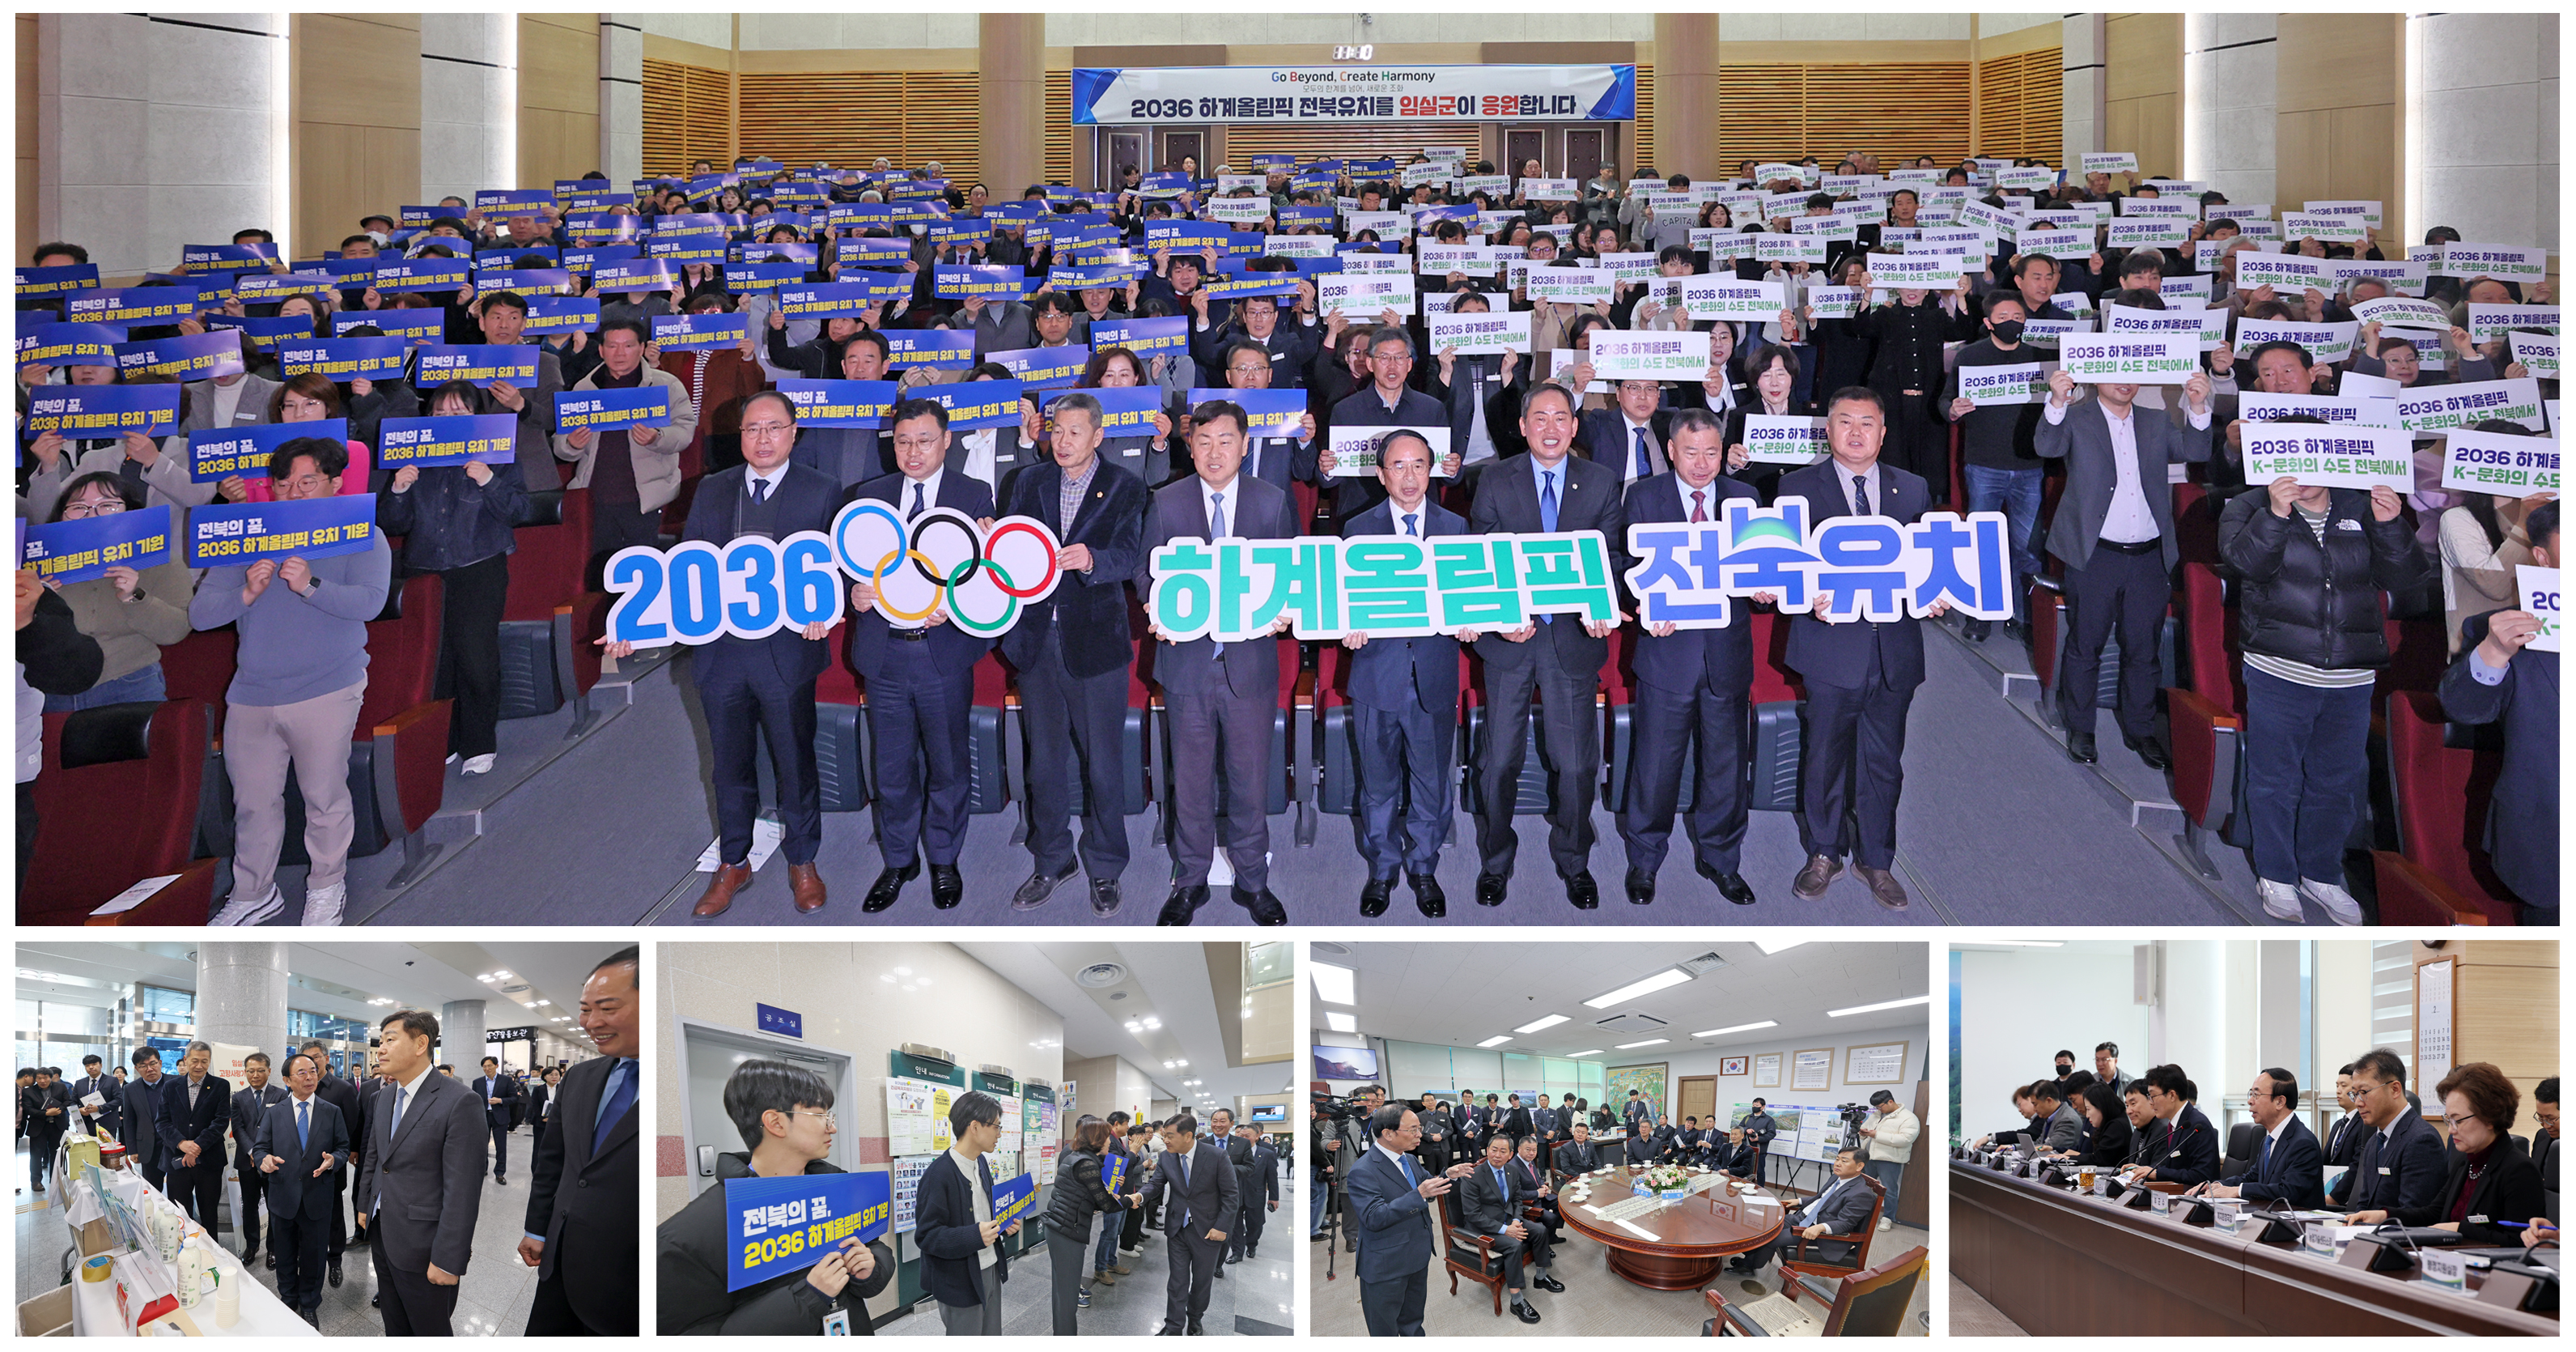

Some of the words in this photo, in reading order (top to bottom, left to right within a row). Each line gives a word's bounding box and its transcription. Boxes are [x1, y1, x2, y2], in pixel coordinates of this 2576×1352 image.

[1335, 45, 1373, 61] 11:10
[1272, 72, 1286, 82] Go
[1290, 71, 1336, 83] Beyond,
[1340, 71, 1378, 82] Create
[1382, 71, 1435, 83] Harmony
[1131, 99, 1194, 117] 2036
[1199, 96, 1294, 117] 하계올림픽
[1299, 96, 1394, 117] 전북유치를
[1399, 96, 1475, 116] 임실군이
[1482, 95, 1577, 116] 응원합니다
[1148, 228, 1169, 238] 전북의
[1171, 228, 1181, 237] 꿈,
[2113, 225, 2134, 233] 2036
[2137, 223, 2171, 232] 하계올림픽
[1148, 240, 1168, 249] 2036
[1170, 238, 1199, 247] 하계올림픽
[1201, 237, 1213, 246] 유치
[1216, 237, 1228, 246] 기원
[1778, 240, 1810, 248] 하계올림픽
[2112, 234, 2141, 242] K-문화의
[2158, 232, 2186, 240] 전북에서
[840, 245, 859, 253] 전북의
[860, 245, 868, 253] 꿈,
[858, 253, 883, 261] 하계올림픽
[2450, 253, 2480, 261] 2036
[2482, 252, 2524, 263] 하계올림픽
[2448, 262, 2489, 272] K-문화의
[2491, 264, 2509, 274] 수도
[2511, 263, 2541, 274] 전북에서
[1687, 291, 1716, 299] 2036
[1718, 289, 1761, 300] 하계올림픽
[71, 300, 105, 311] 전북의
[109, 298, 123, 309] 꿈,
[1687, 301, 1724, 312] K-문화의
[1727, 300, 1745, 311] 수도
[1747, 300, 1781, 311] 전북에서
[72, 312, 103, 322] 2036
[106, 308, 151, 320] 하계올림픽
[155, 305, 172, 316] 유치
[175, 303, 193, 314] 기원
[656, 325, 680, 334] 전북의
[681, 324, 693, 334] 꿈,
[1435, 325, 1462, 335] 2036
[1465, 321, 1507, 333] 하계올림픽
[656, 336, 678, 346] 2036
[681, 332, 714, 343] 하계올림픽
[715, 331, 728, 340] 유치
[731, 329, 744, 339] 기원
[1435, 337, 1471, 347] K-문화의
[1475, 335, 1491, 344] 수도
[1494, 332, 1526, 342] 전북에서
[2067, 347, 2104, 359] 2036
[2108, 345, 2166, 357] 하계올림픽
[422, 356, 452, 368] 전북의
[456, 355, 469, 367] 꿈,
[2067, 361, 2117, 374] K-문화의
[2120, 359, 2144, 372] 수도
[2147, 359, 2193, 372] 전북에서
[421, 371, 449, 381] 2036
[452, 368, 494, 379] 하계올림픽
[498, 367, 516, 378] 유치
[518, 365, 534, 377] 기원
[32, 400, 65, 413] 전북의
[68, 398, 83, 412] 꿈,
[560, 402, 588, 415] 전북의
[591, 400, 604, 411] 꿈,
[29, 418, 59, 430] 2036
[62, 414, 117, 427] 하계올림픽
[121, 412, 145, 424] 유치
[148, 409, 172, 423] 기원
[561, 415, 588, 427] 2036
[590, 410, 630, 423] 하계올림픽
[631, 407, 647, 419] 유치
[649, 406, 666, 417] 기원
[384, 430, 417, 445] 전북의
[420, 429, 435, 443] 꿈,
[384, 448, 414, 461] 2036
[416, 442, 465, 457] 하계올림픽
[467, 440, 487, 453] 유치
[490, 437, 510, 451] 기원
[2251, 441, 2299, 454] 2036
[2304, 439, 2374, 455] 하계올림픽
[2252, 459, 2318, 474] K-문화의
[2323, 459, 2351, 474] 수도
[2355, 460, 2406, 475] 전북에서
[197, 520, 243, 538] 전북의
[248, 519, 266, 534] 꿈,
[198, 542, 240, 557] 2036
[244, 533, 308, 554] 하계올림픽
[312, 526, 339, 544] 유치
[342, 522, 369, 539] 기원
[614, 540, 837, 640] 2036
[1156, 529, 1613, 633] 하계올림픽
[1633, 504, 2003, 621] 전북유치
[915, 1065, 927, 1075] 안내
[929, 1072, 950, 1080] INFORMATION
[744, 1201, 806, 1237] 전북의
[812, 1196, 831, 1225] 꿈,
[744, 1231, 804, 1269] 2036
[808, 1213, 861, 1248] 하계올림픽
[863, 1209, 876, 1229] 유치
[876, 1201, 888, 1220] 기원
